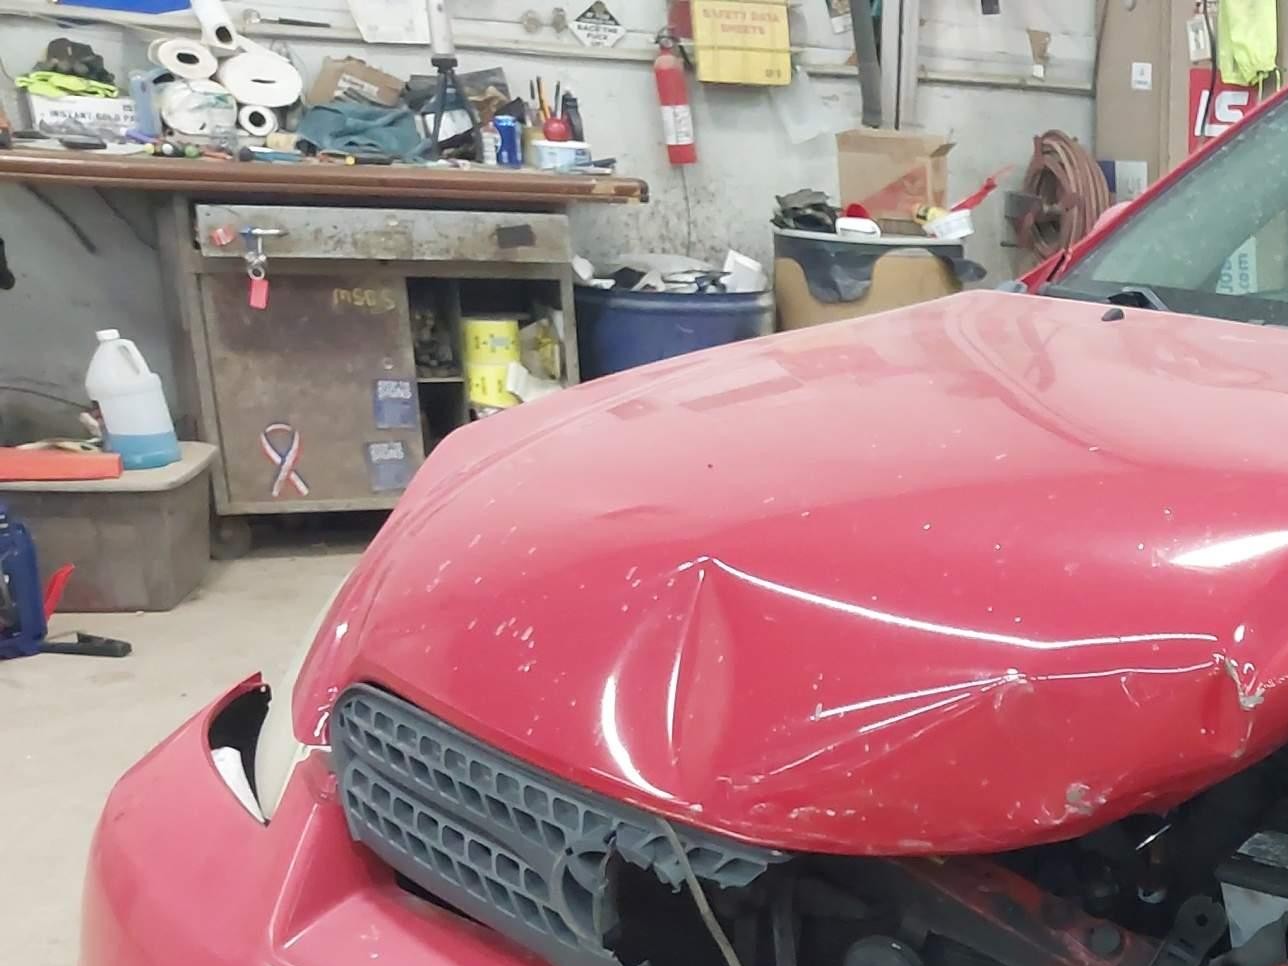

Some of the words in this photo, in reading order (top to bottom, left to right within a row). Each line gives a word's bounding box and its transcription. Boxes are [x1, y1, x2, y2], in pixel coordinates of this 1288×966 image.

[702, 8, 746, 20] SAFETY
[751, 11, 780, 23] DATA
[720, 23, 766, 35] SHEETS
